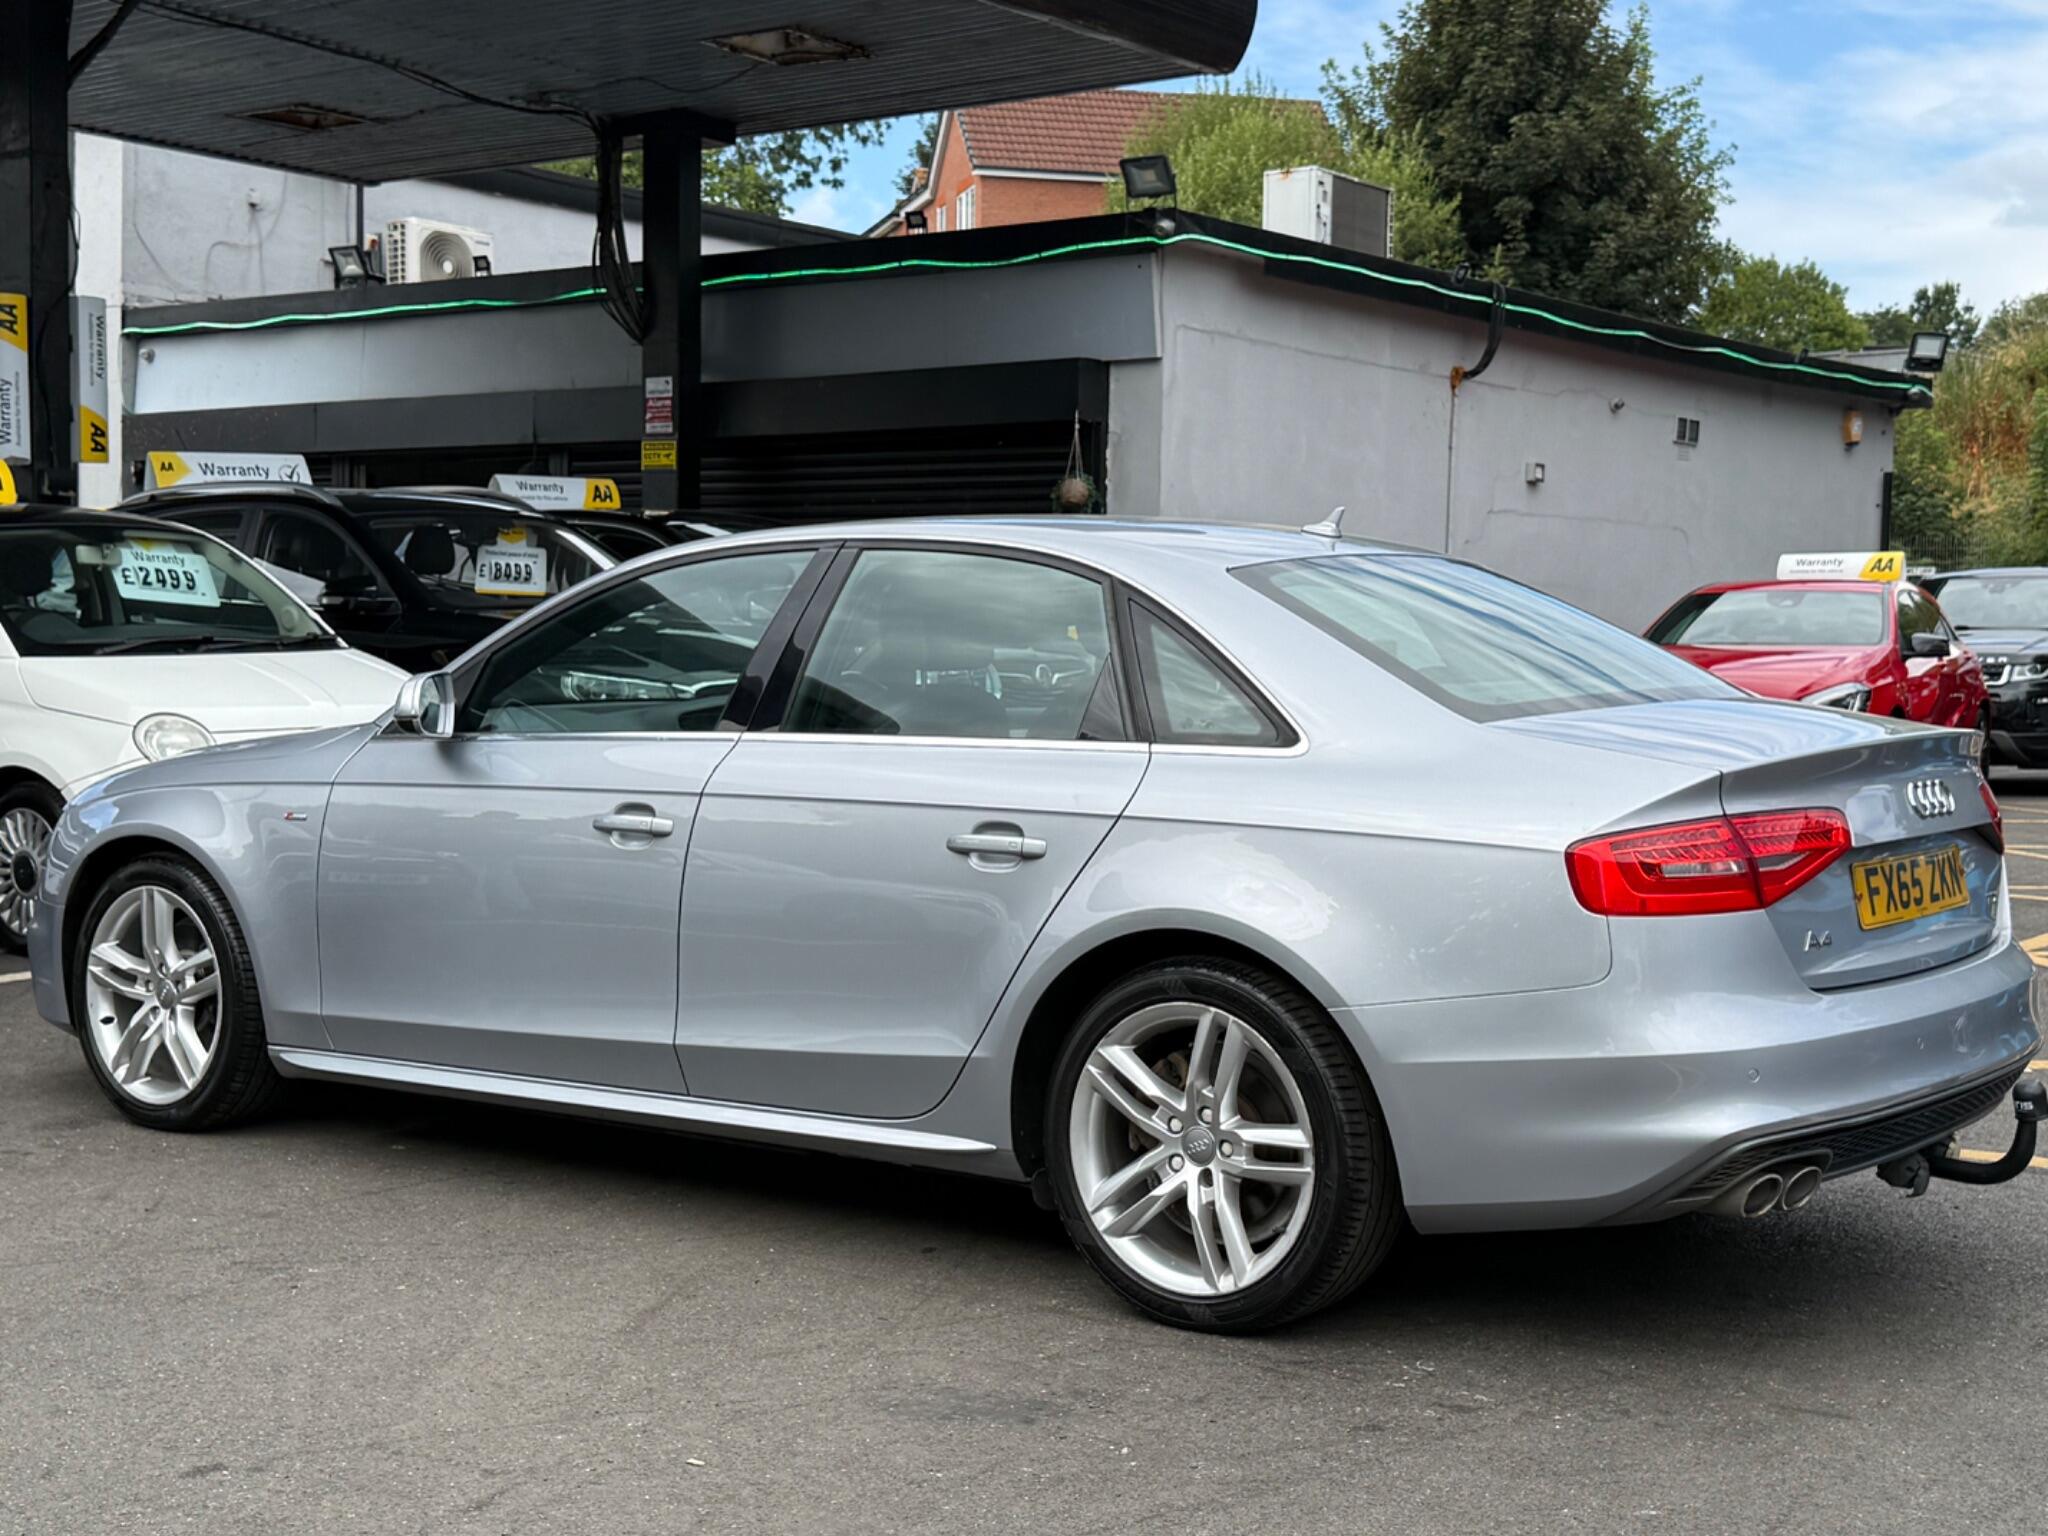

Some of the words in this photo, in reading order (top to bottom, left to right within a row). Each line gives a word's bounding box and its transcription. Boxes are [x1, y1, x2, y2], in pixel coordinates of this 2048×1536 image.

[0, 304, 18, 336] AA
[95, 315, 105, 380] Warranty
[0, 378, 12, 445] Warranty
[90, 422, 106, 452] AA
[160, 461, 175, 472] AA
[198, 462, 269, 479] Warranty
[515, 481, 564, 494] Warranty
[592, 485, 613, 502] AA
[131, 551, 185, 567] Warranty
[1796, 558, 1844, 567] Warranty
[1870, 557, 1894, 572] AA
[1864, 861, 1924, 916] FX65
[1926, 853, 1963, 902] ZKN
[1804, 930, 1832, 951] A4
